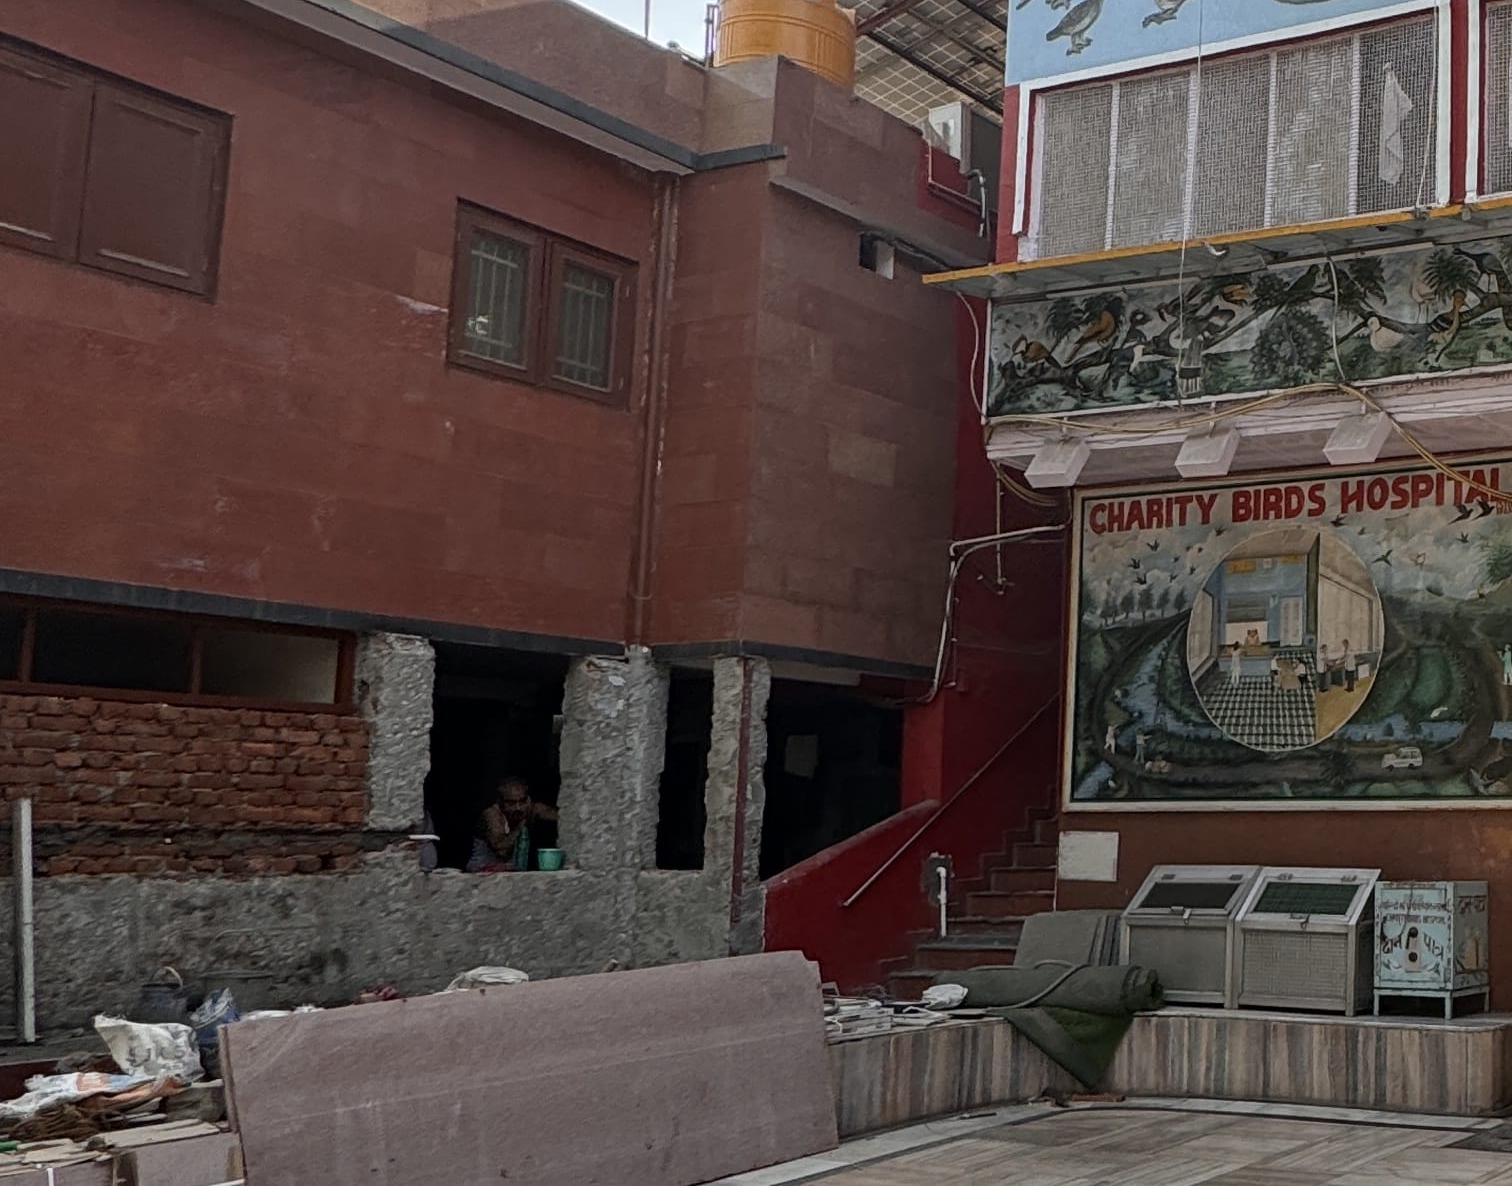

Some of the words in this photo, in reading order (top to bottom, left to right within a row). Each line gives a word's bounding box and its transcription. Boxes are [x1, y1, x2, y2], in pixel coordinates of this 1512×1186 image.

[1089, 493, 1217, 535] CHARITY
[1232, 482, 1326, 523] BIRDS
[1341, 467, 1511, 514] HOSPITAL
